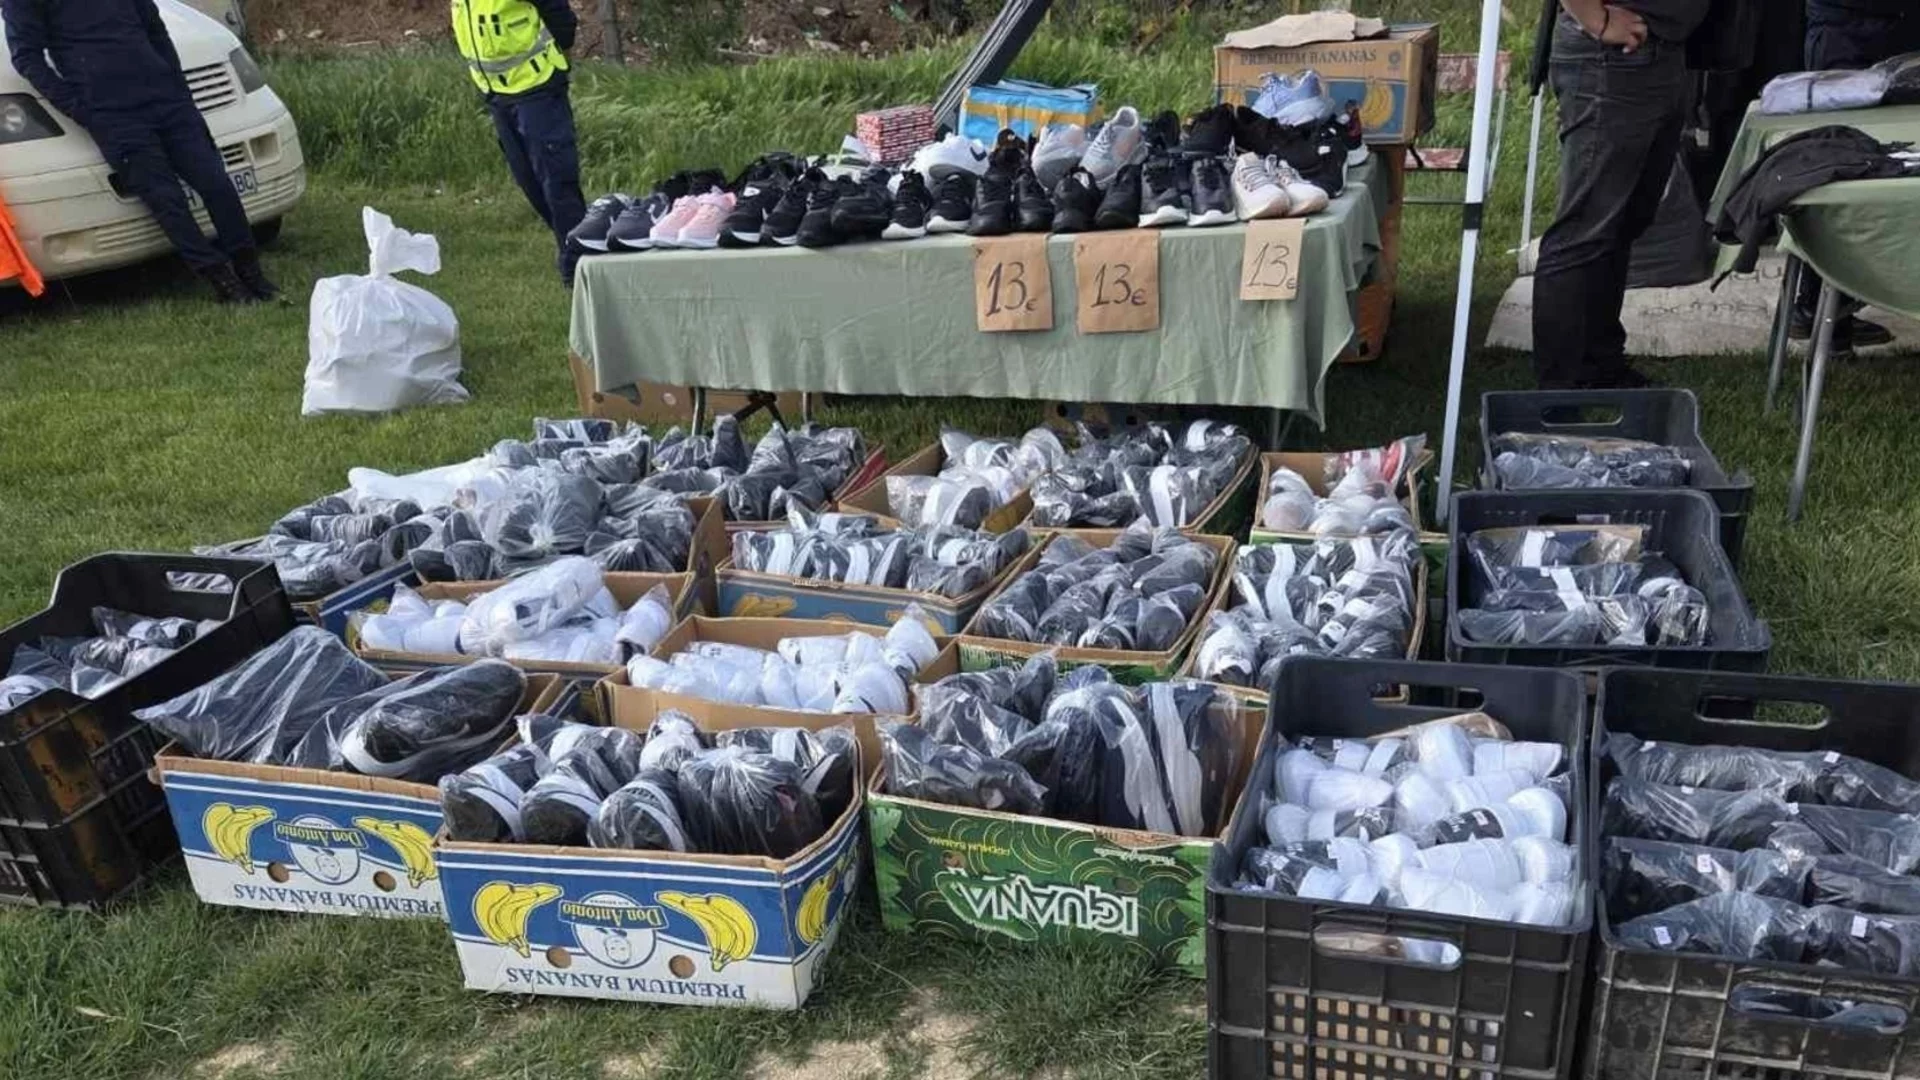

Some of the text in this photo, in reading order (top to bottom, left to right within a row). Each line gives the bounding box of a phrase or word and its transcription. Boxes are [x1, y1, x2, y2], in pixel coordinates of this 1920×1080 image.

[1240, 50, 1377, 66] PREMIUM BANANAS
[276, 824, 361, 848] Don Antonio
[233, 883, 443, 916] PREMIUM BANANAS
[953, 872, 1139, 937] IGUANA
[561, 902, 662, 927] Don Antonio
[507, 967, 747, 1000] PREMIUM BANANAS
